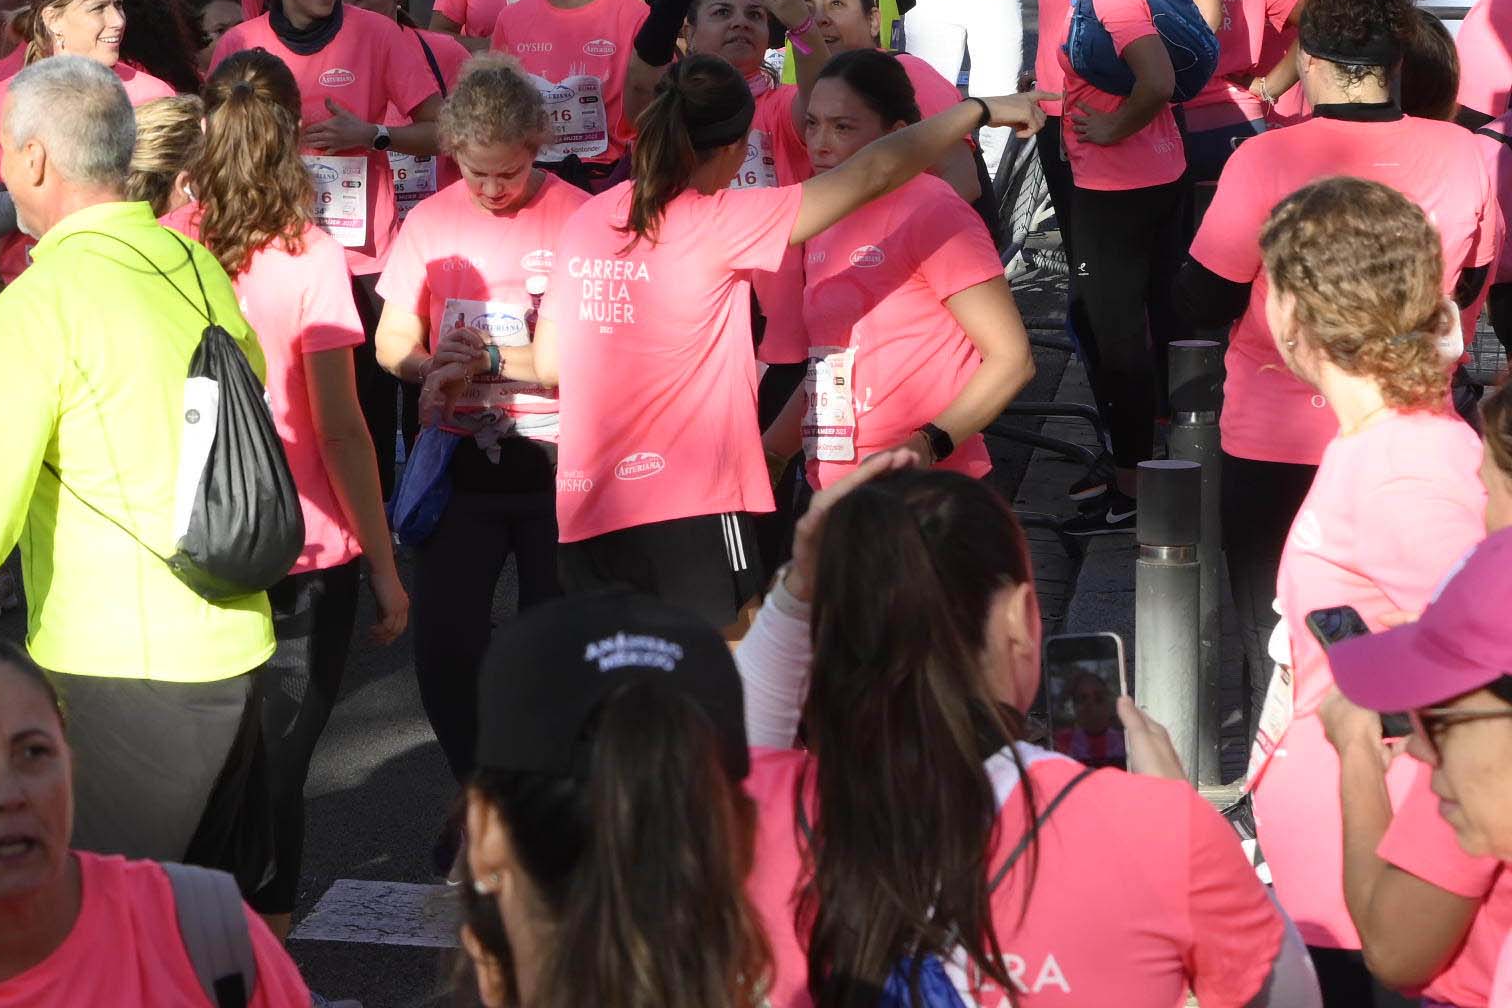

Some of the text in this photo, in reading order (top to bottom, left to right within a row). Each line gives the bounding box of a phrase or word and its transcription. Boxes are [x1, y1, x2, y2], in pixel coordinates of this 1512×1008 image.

[517, 43, 553, 53] OYSHO
[551, 109, 572, 122] 16
[736, 171, 757, 186] 16
[568, 257, 650, 281] CARRERA
[583, 280, 630, 301] DE LA
[579, 303, 635, 324] MUJER
